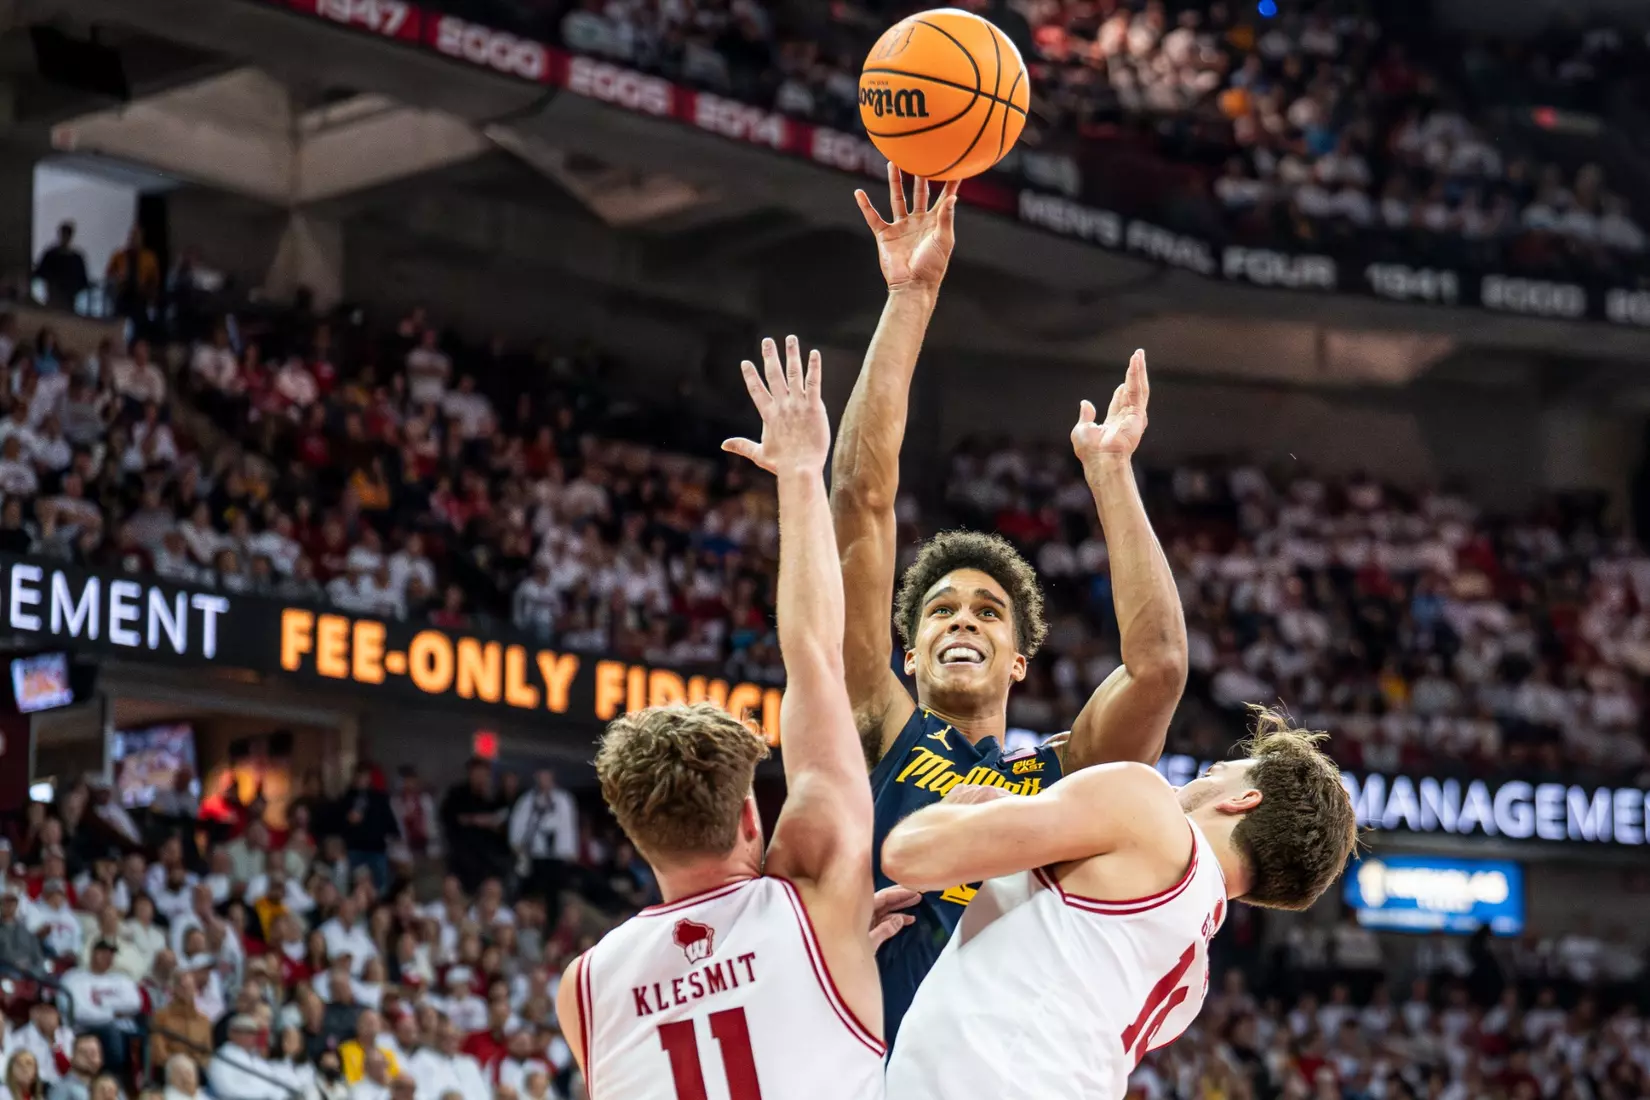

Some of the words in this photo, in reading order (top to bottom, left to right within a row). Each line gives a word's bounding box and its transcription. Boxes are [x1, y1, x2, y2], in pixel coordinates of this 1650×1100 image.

[436, 16, 545, 79] 2000
[858, 88, 930, 118] Wilso
[280, 607, 579, 713] FEE-ONLY
[1341, 771, 1650, 845] MANAGEME
[632, 952, 756, 1017] KLESMIT
[658, 1006, 762, 1100] 11
